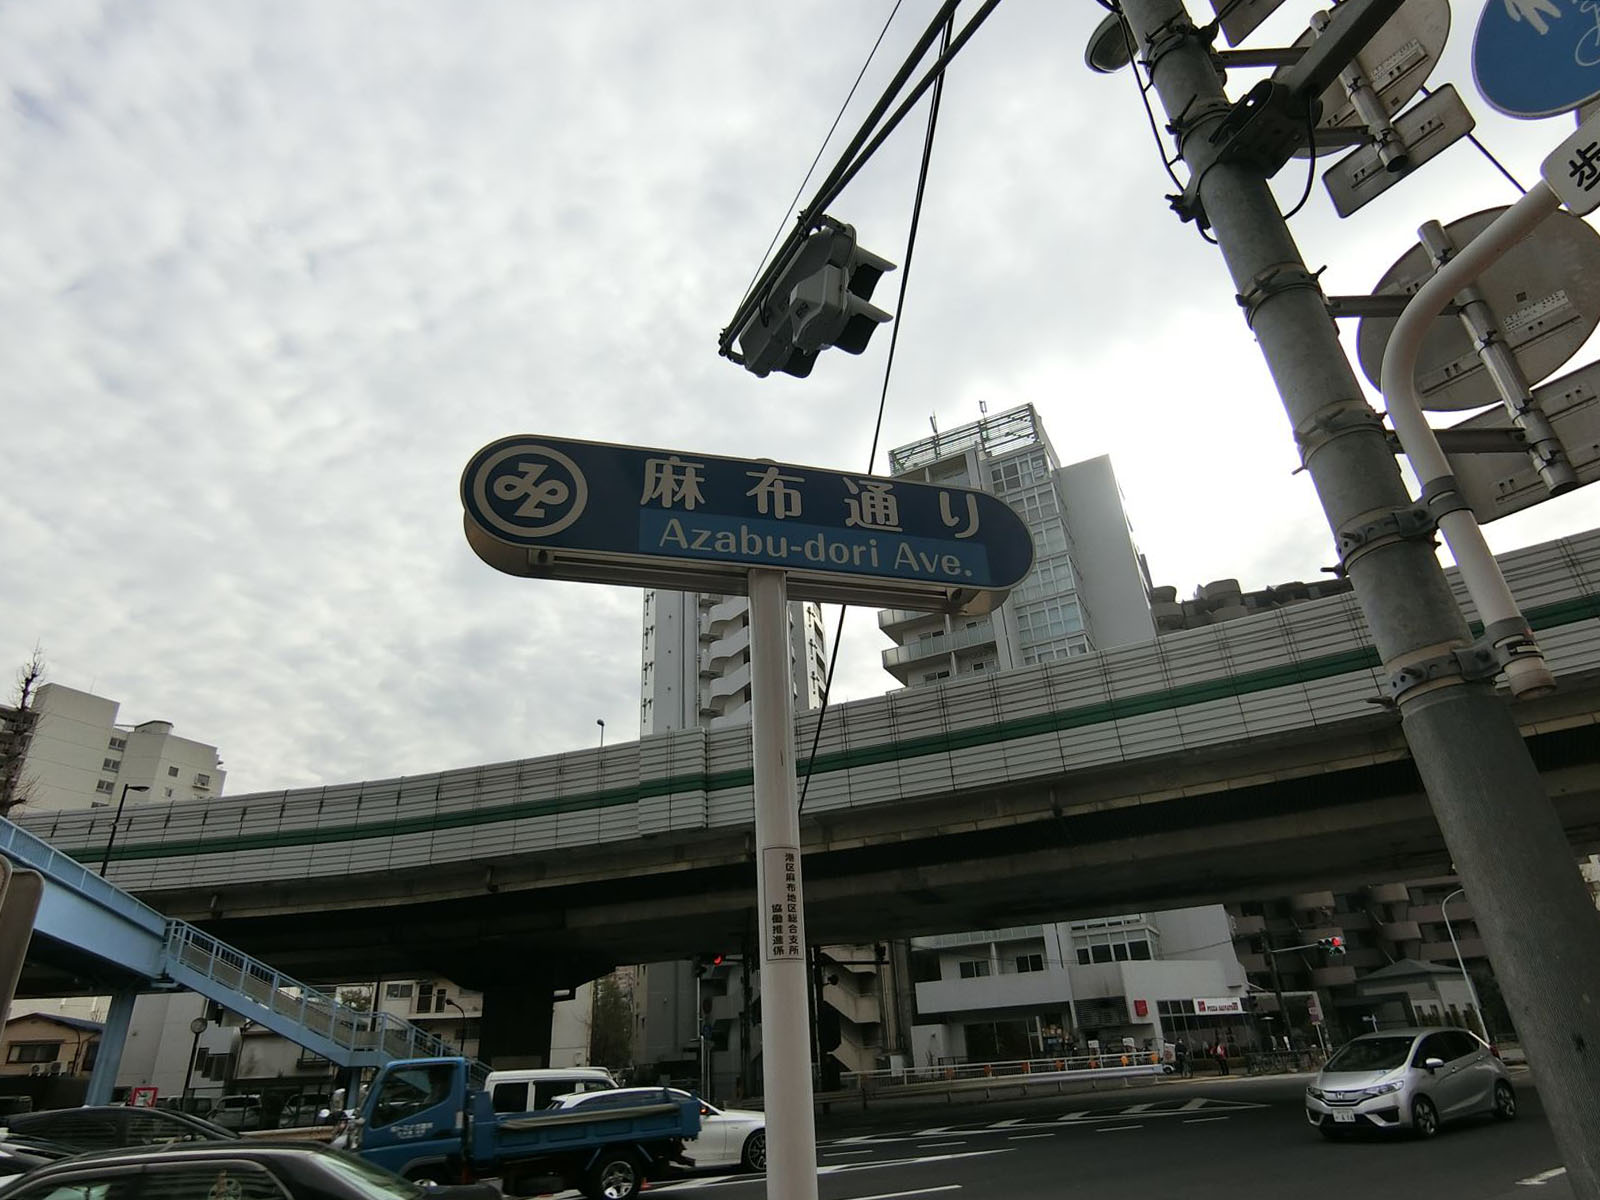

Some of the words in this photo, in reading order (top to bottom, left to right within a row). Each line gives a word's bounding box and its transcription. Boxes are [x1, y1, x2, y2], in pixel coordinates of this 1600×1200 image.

[640, 455, 980, 539] 麻布通り
[659, 518, 879, 568] Azabu-dori
[894, 542, 973, 577] Ave.
[771, 903, 785, 956] 協働推進係
[785, 852, 799, 955] 港区麻布地区総合支所
